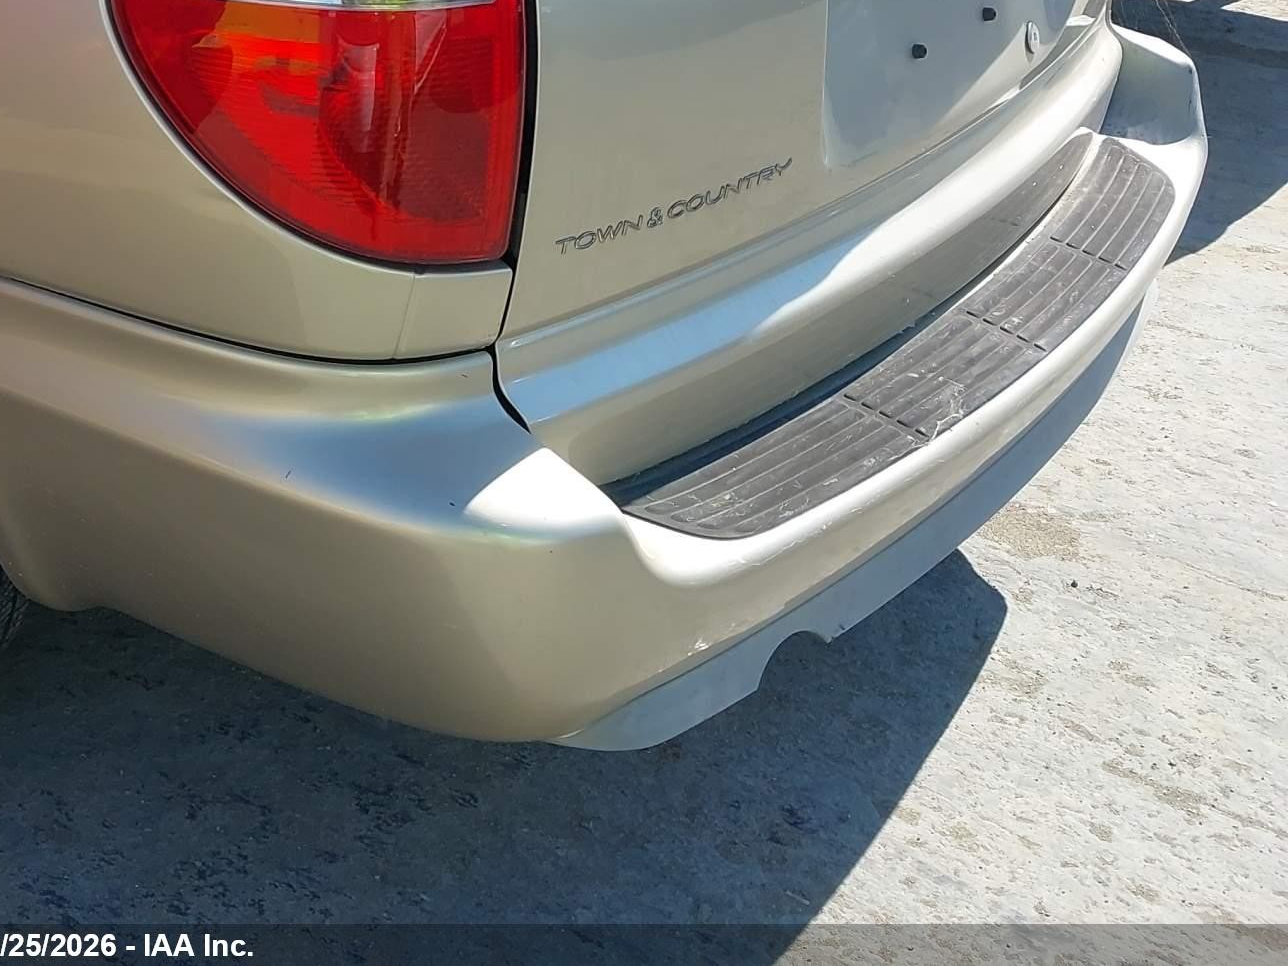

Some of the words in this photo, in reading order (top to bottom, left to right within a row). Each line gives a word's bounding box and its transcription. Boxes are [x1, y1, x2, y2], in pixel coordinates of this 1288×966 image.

[555, 215, 643, 255] TOWN
[647, 207, 663, 228] &
[667, 157, 792, 219] COUNTRY
